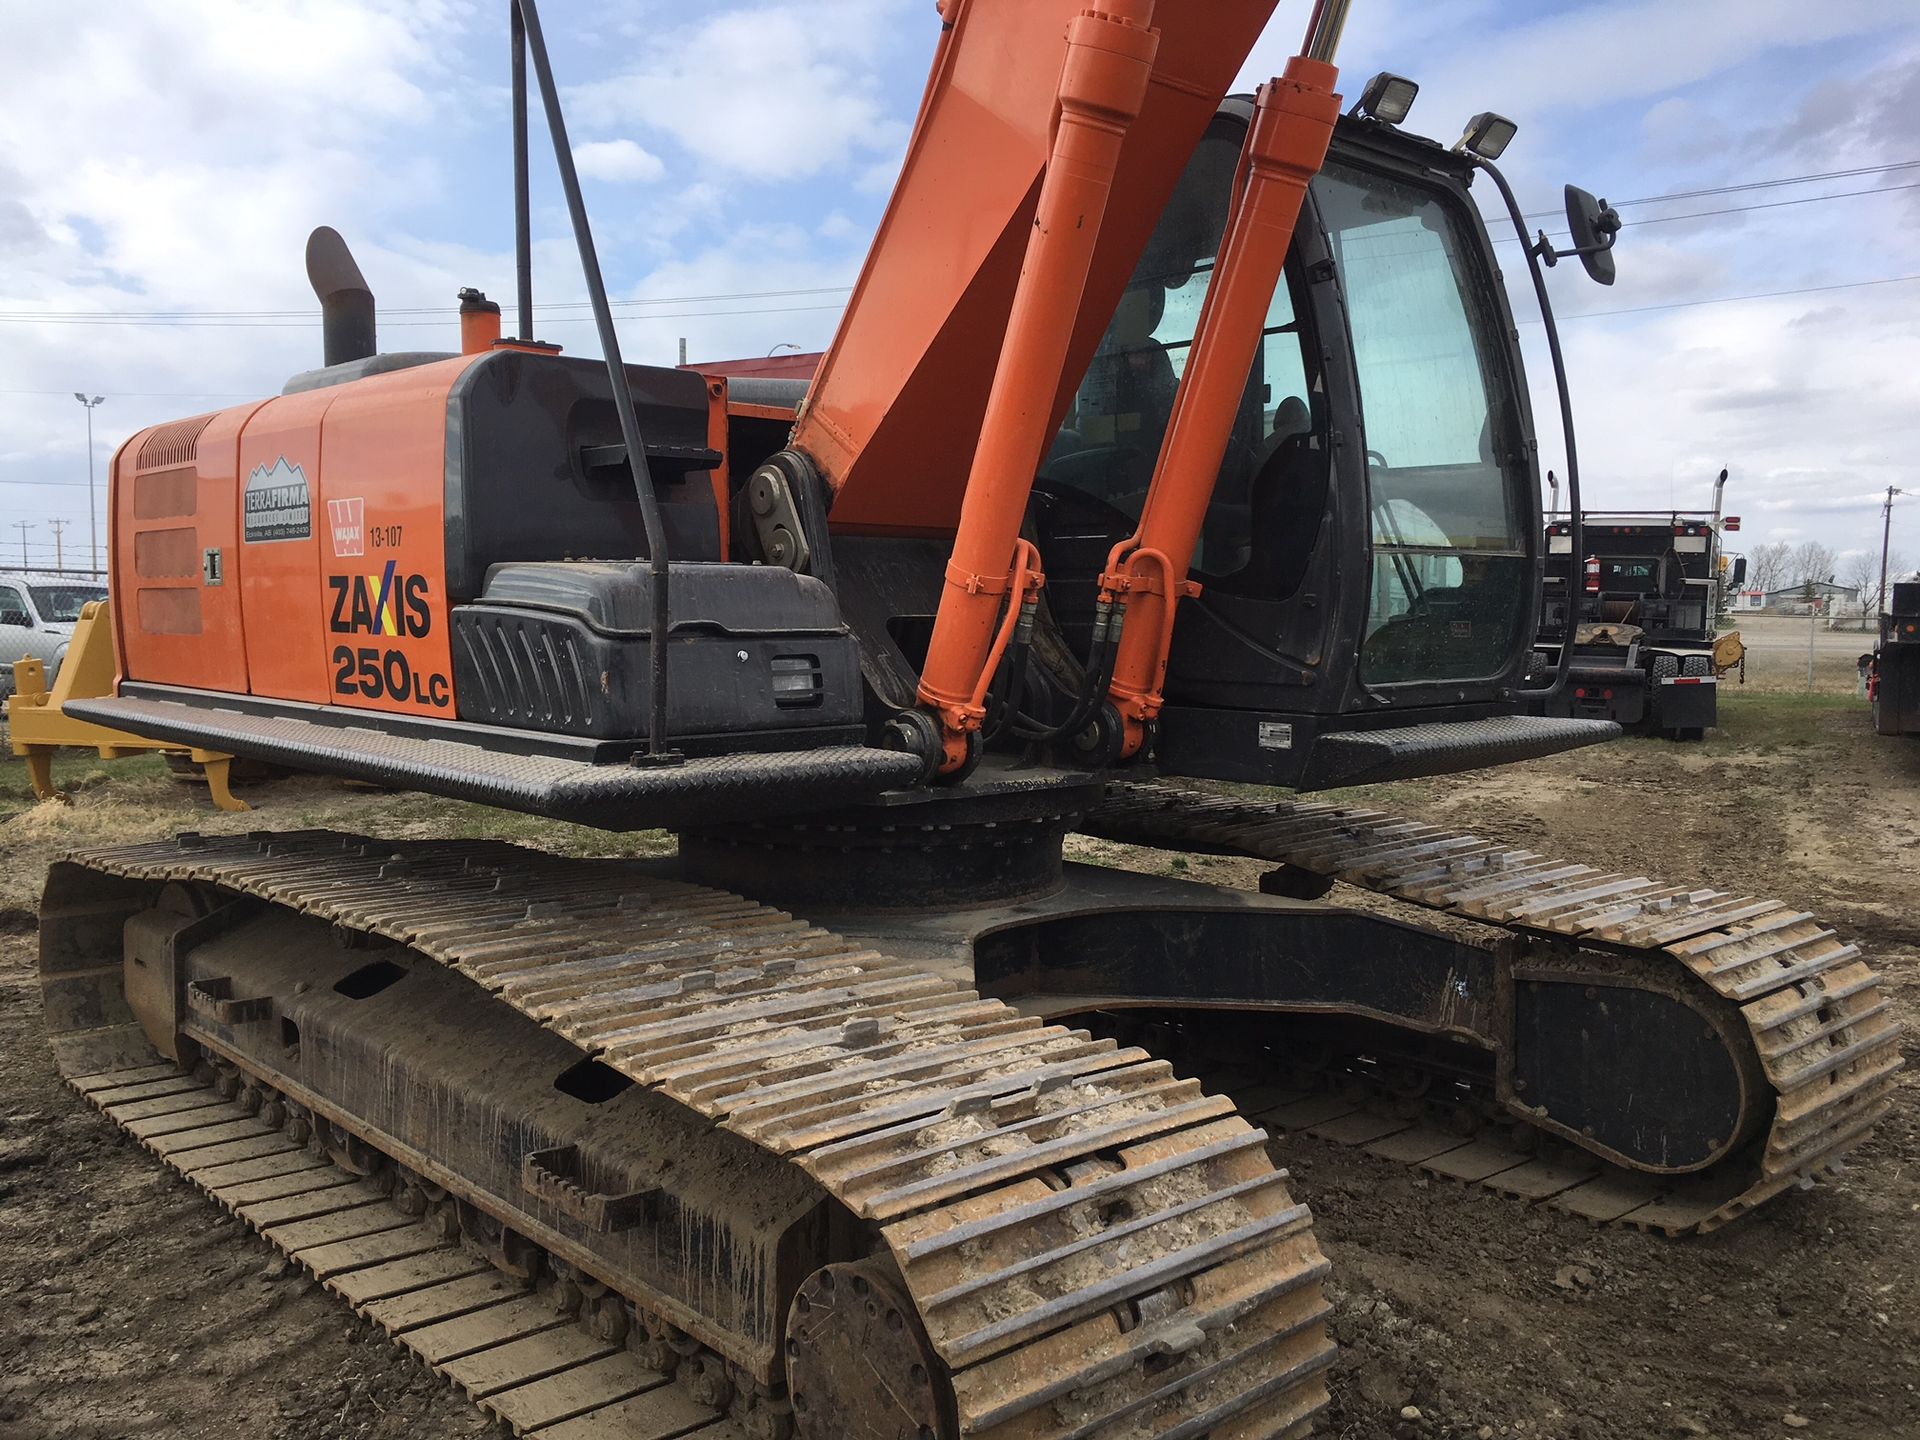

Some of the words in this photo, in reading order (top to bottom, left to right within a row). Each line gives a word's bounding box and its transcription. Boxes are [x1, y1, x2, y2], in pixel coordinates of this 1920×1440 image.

[246, 486, 309, 511] TERRAFIRMA
[335, 526, 359, 544] WAJAX
[370, 526, 402, 547] 13-107
[329, 560, 431, 638] ZAXIS
